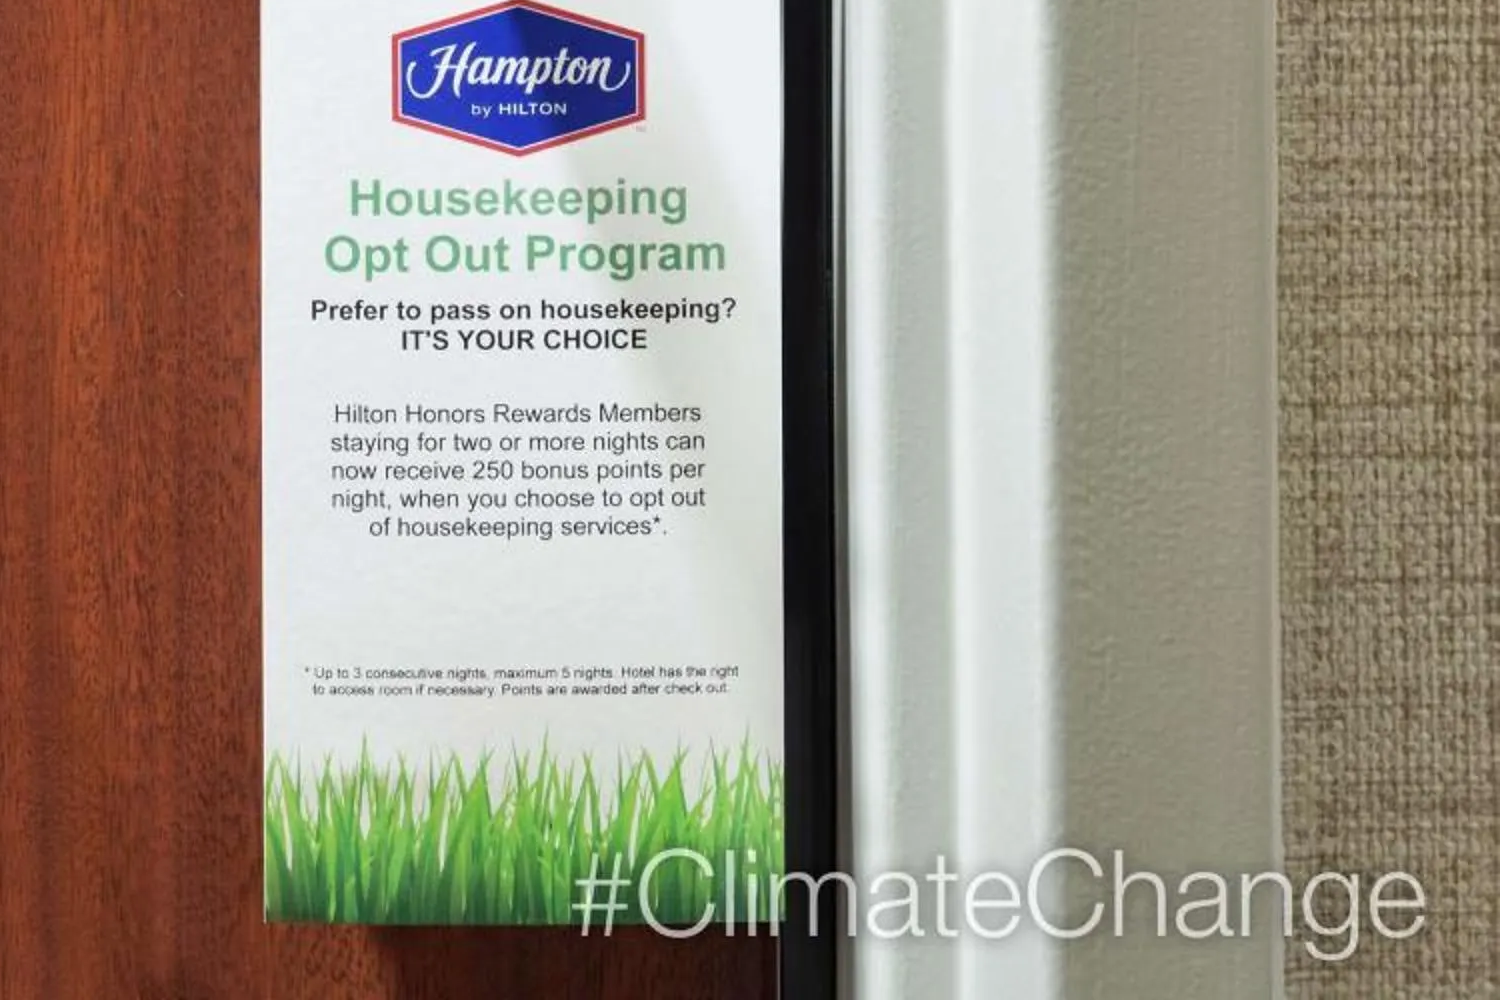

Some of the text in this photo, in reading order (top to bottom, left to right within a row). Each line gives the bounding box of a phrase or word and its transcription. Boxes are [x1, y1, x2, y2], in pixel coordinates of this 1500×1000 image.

[406, 41, 631, 99] Hampton
[471, 102, 567, 118] by HILTON
[350, 179, 687, 225] Housekeeping
[324, 234, 726, 281] Opt Out Program
[310, 297, 736, 326] Prefer to pass on housekeeping?
[401, 328, 648, 351] IT'S YOUR CHOICE
[334, 402, 702, 424] Hilton Honors Rewards Members
[330, 431, 706, 456] staying for two or more nights can
[332, 459, 706, 484] now receive 250 bonus points per
[332, 487, 706, 513] night, when you choose to opt out
[369, 516, 390, 538] of
[397, 515, 553, 541] housekeeping
[314, 668, 332, 680] Up
[337, 668, 349, 679] to
[354, 667, 361, 679] 3
[366, 667, 442, 679] consecutive
[494, 667, 556, 679] maximum
[562, 667, 570, 678] 5
[622, 666, 654, 677] Hotel
[659, 666, 682, 677] has
[686, 666, 706, 676] the
[711, 666, 739, 679] right
[313, 685, 325, 695] to
[329, 686, 373, 695] access
[379, 686, 412, 695] room
[416, 684, 424, 695] if
[501, 684, 542, 695] Points
[548, 685, 567, 695] are
[572, 683, 627, 695] awarded
[632, 683, 659, 694] after
[664, 683, 702, 694] check
